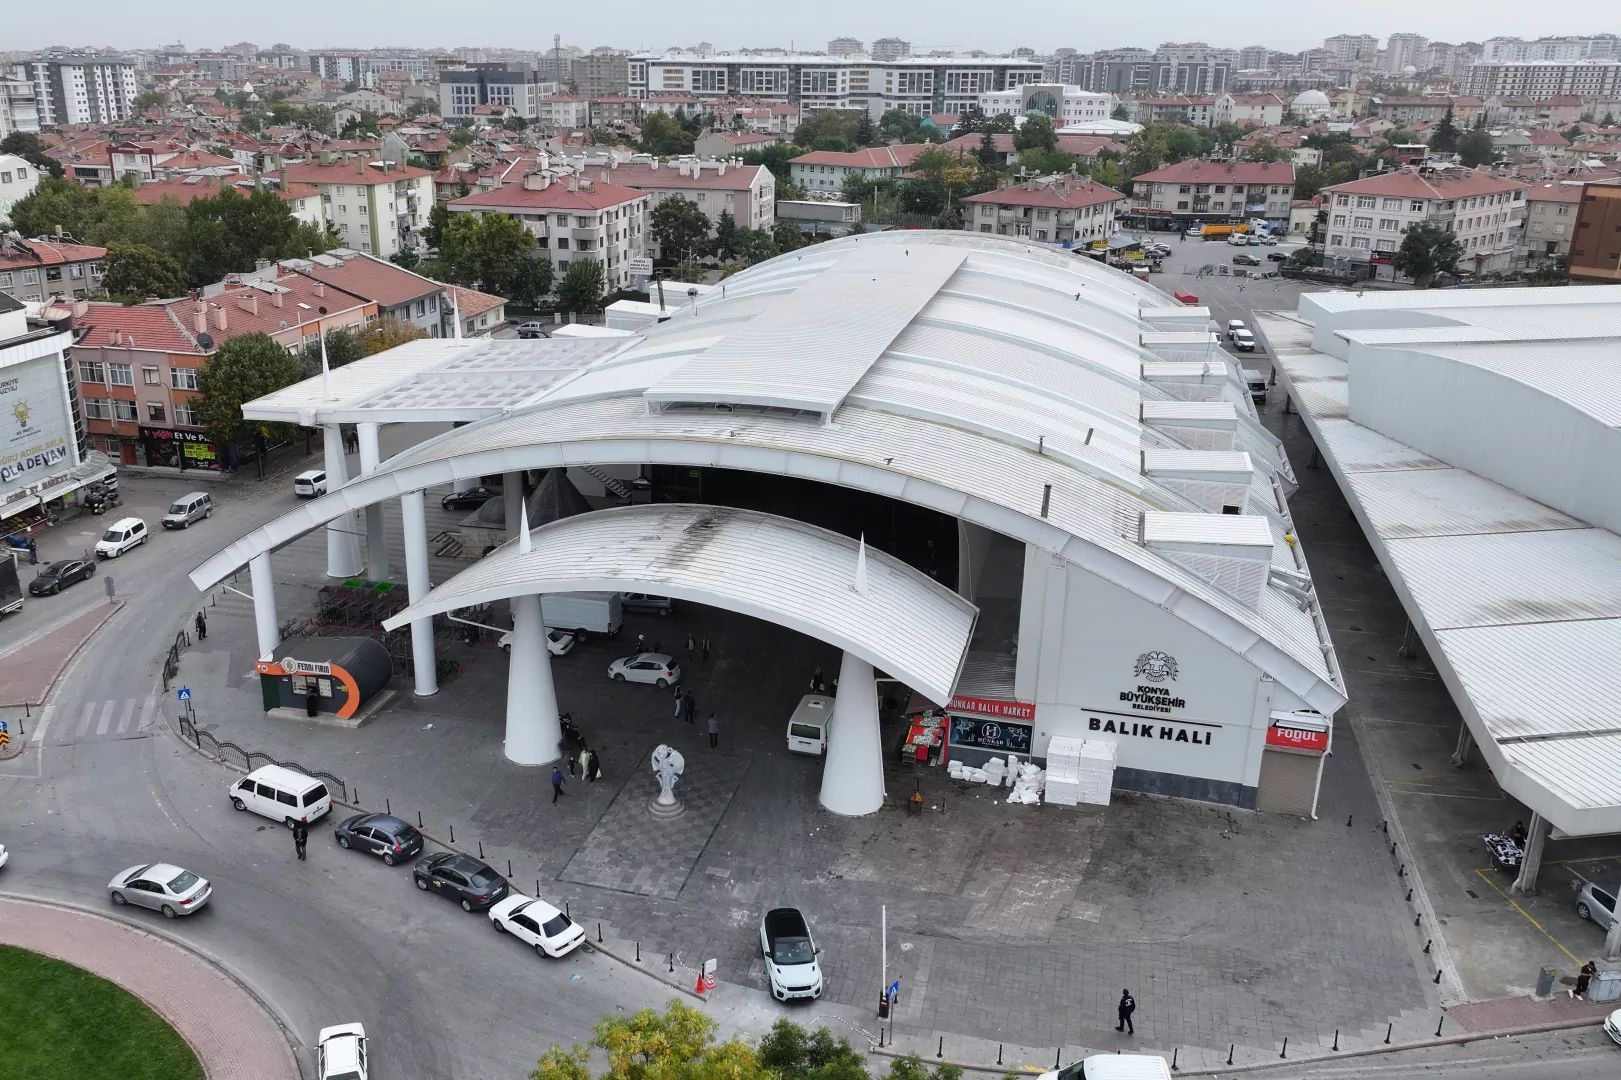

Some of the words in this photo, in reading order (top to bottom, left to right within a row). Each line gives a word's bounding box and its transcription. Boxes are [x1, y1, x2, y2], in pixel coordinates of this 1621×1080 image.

[20, 437, 64, 459] ADIMLARLA
[26, 445, 66, 470] DEVAM
[1137, 685, 1170, 696] KONYA
[948, 699, 975, 710] HÜNKAR
[978, 702, 999, 714] BALIK
[1003, 705, 1030, 717] MARKET
[1119, 691, 1186, 708] BÜYÜKŞEHİR
[1132, 704, 1171, 713] BELEDİYESİ
[1088, 718, 1154, 738] BALIK
[1160, 726, 1212, 746] HALİ
[1277, 728, 1318, 742] FODUL
